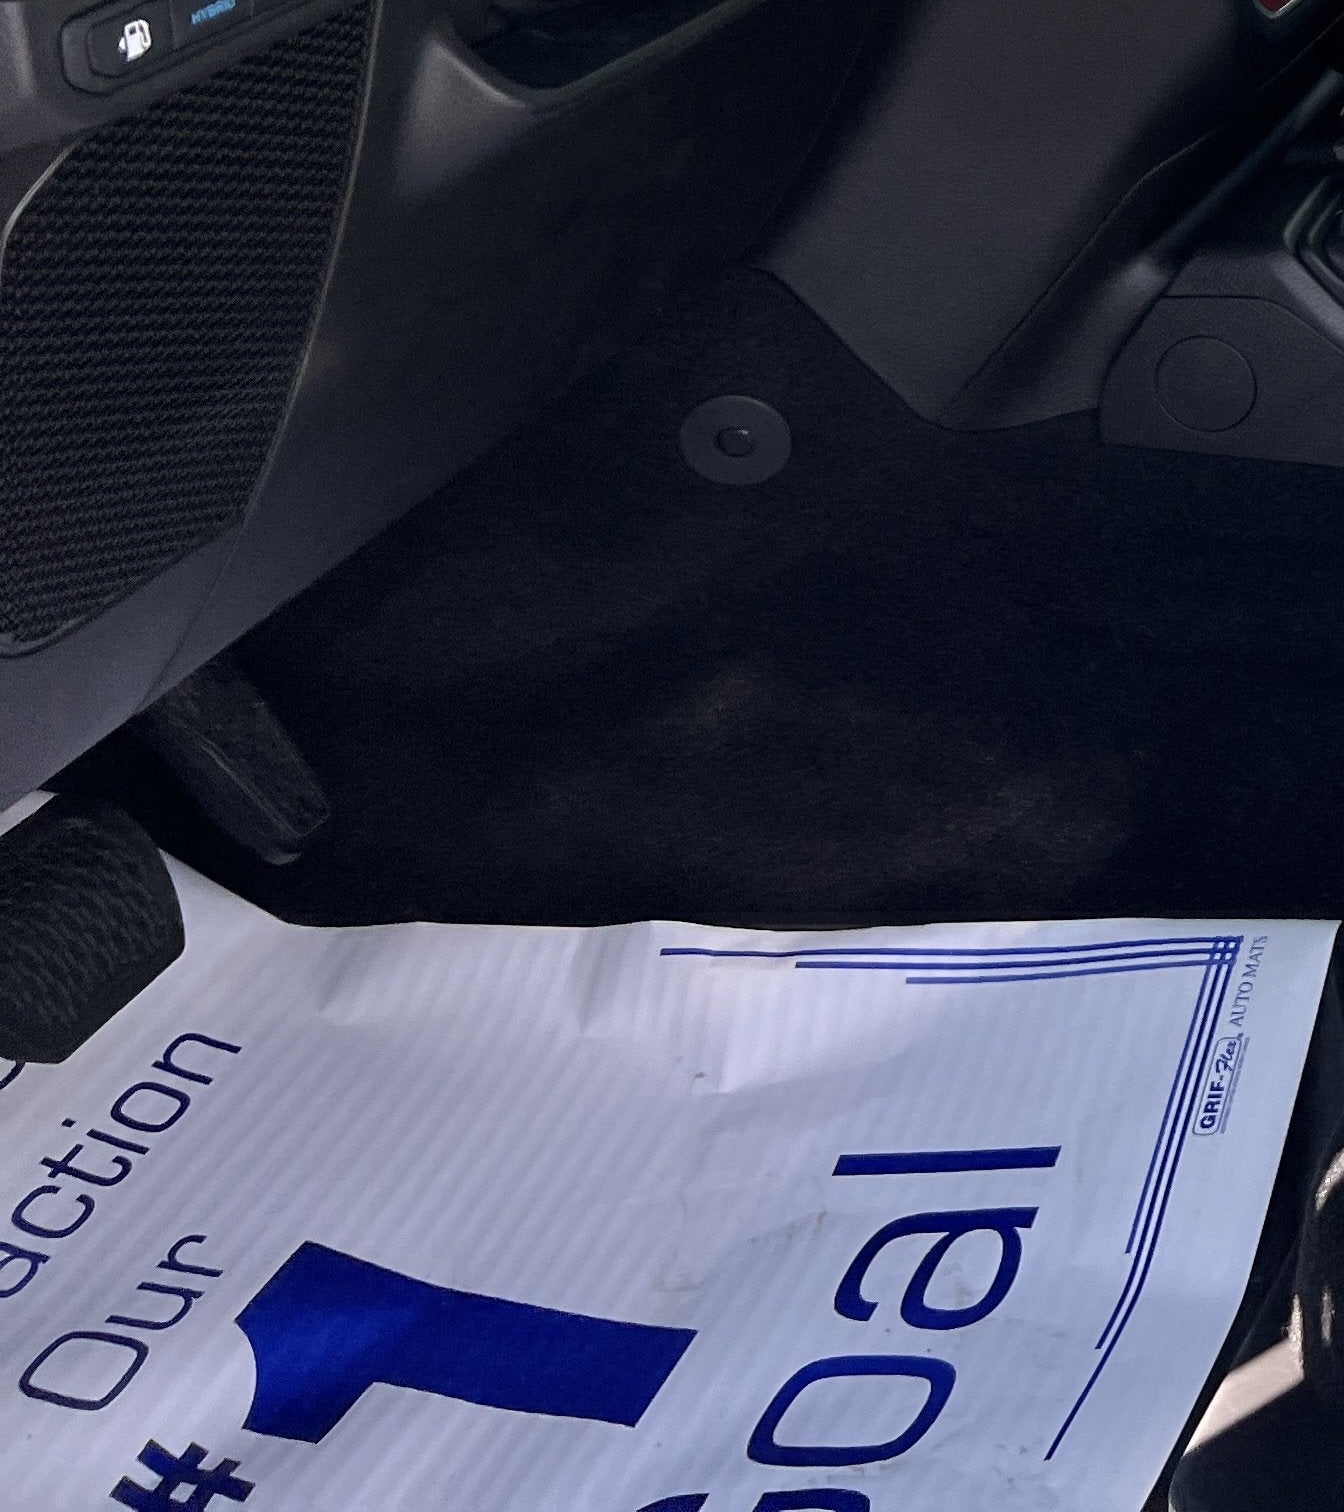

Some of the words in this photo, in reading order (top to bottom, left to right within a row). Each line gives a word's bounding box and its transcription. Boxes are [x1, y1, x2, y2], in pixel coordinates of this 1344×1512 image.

[1229, 980, 1254, 1028] AUTO
[1242, 935, 1269, 979] MATS
[18, 1234, 224, 1411] Our
[635, 1145, 1062, 1512] oal
